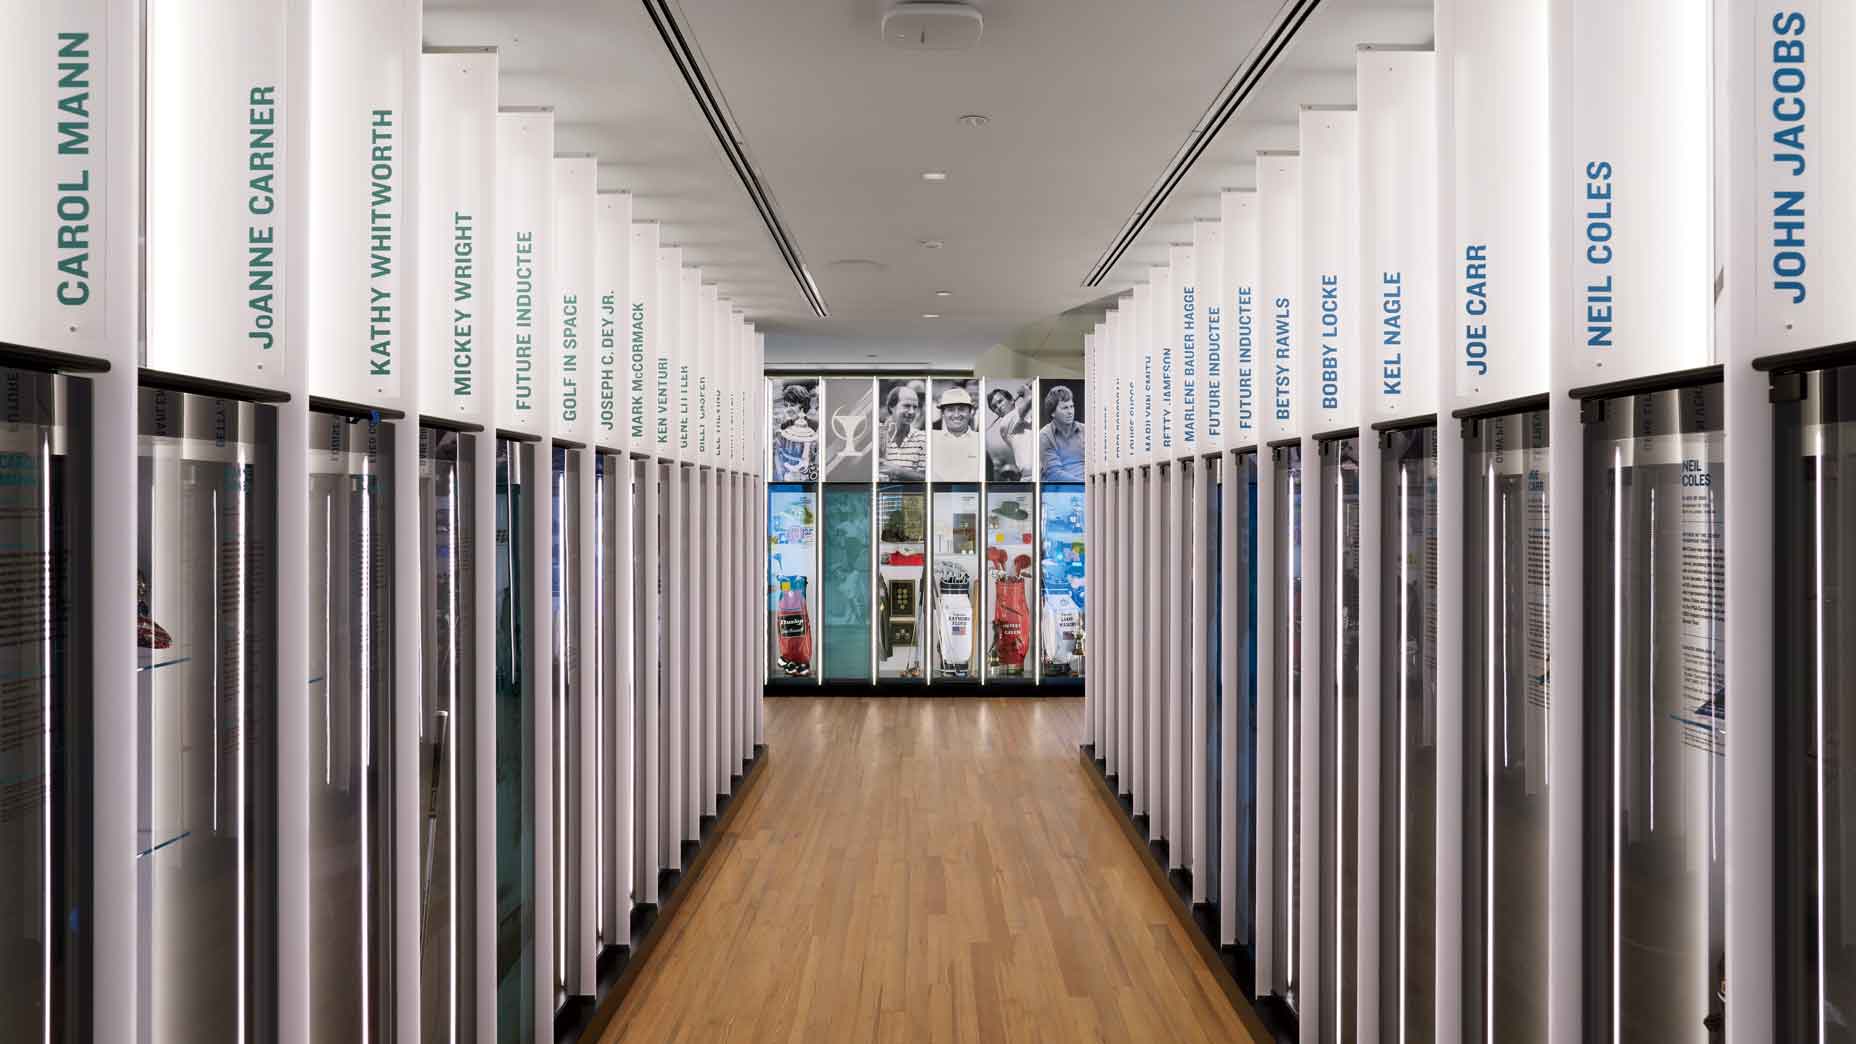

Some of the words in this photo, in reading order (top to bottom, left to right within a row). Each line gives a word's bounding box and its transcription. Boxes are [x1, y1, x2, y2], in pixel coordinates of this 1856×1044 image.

[58, 33, 89, 154] MANN
[1773, 12, 1805, 176] JACOBS
[249, 87, 274, 214] CARNER
[371, 110, 392, 278] WHITWORTH
[1587, 162, 1612, 264] COLES
[57, 170, 89, 305] CAROL
[455, 212, 472, 301] WRIGHT
[1773, 192, 1806, 304] JOHN
[249, 227, 273, 349] JoANNE
[517, 232, 532, 327] INDUCTEE
[602, 291, 614, 314] JR.
[1183, 286, 1195, 330] HAGGE
[1322, 275, 1337, 337] LOCKE
[1384, 272, 1401, 344] NAGLE
[1466, 246, 1487, 315] CARR
[370, 288, 391, 375] KATHY
[563, 295, 577, 349] SPACE
[602, 318, 614, 348] DEY
[1208, 306, 1221, 377] INDUCTEE
[1239, 288, 1251, 362] INDUCTEE
[1276, 298, 1289, 358] RAWLS
[1587, 276, 1612, 346] NEIL
[454, 309, 471, 395] MICKEY
[516, 334, 531, 410] FUTURE
[564, 355, 576, 371] IN
[631, 303, 644, 392] McCORMACK
[1183, 334, 1195, 376] BAUER
[1322, 345, 1337, 408] BOBBY
[1384, 353, 1401, 394] KEL
[1466, 325, 1487, 375] JOE
[563, 378, 576, 421] GOLF
[601, 370, 613, 430] JOSEPH
[631, 395, 644, 438] MARK
[657, 357, 669, 414] VENTURI
[1183, 380, 1195, 442] MARLENE
[1208, 380, 1221, 436] FUTURE
[1239, 367, 1252, 429] FUTURE
[1276, 365, 1289, 419] BETSY
[656, 417, 668, 444] KEN
[1682, 459, 1702, 473] NEIL
[1682, 474, 1712, 487] COLES
